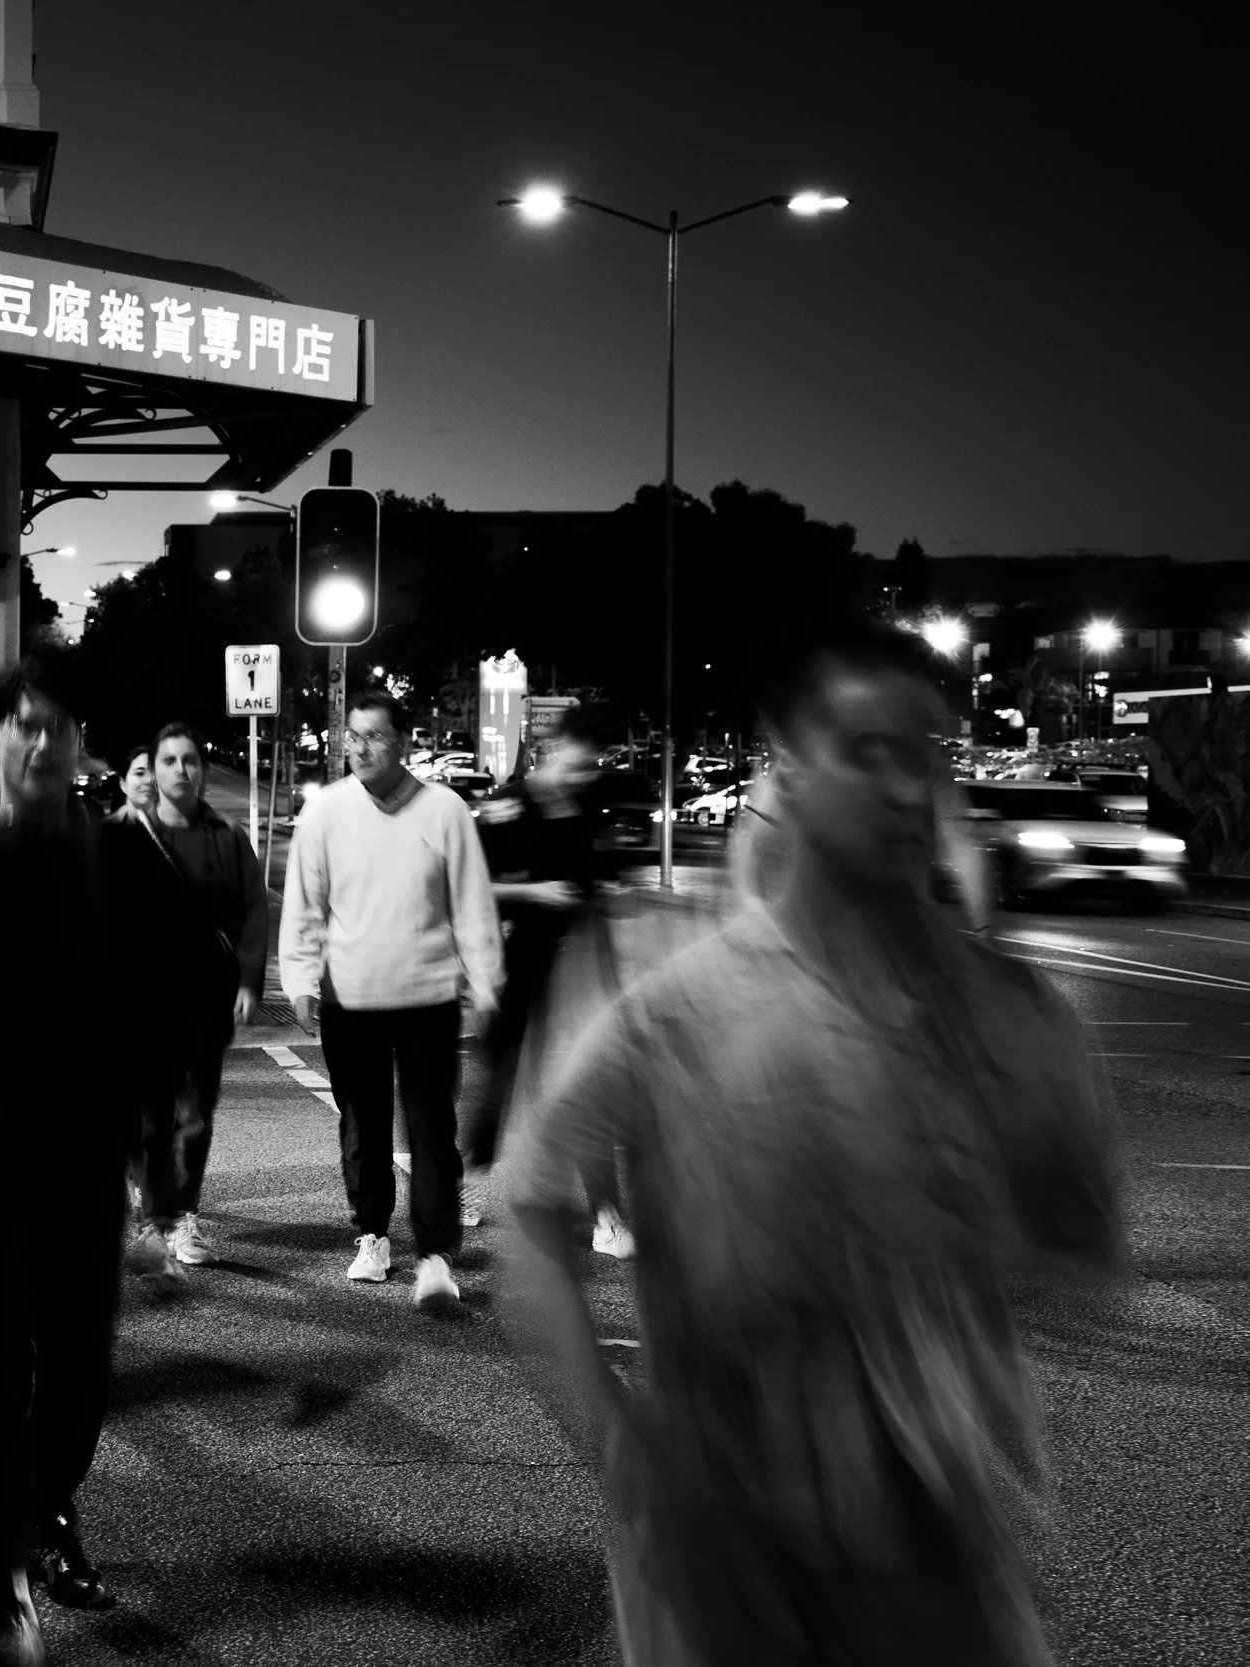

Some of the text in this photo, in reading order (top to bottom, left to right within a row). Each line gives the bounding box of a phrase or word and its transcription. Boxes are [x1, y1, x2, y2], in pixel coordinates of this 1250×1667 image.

[233, 653, 272, 666] FORM
[247, 669, 255, 692] 1
[234, 697, 273, 710] LANE
